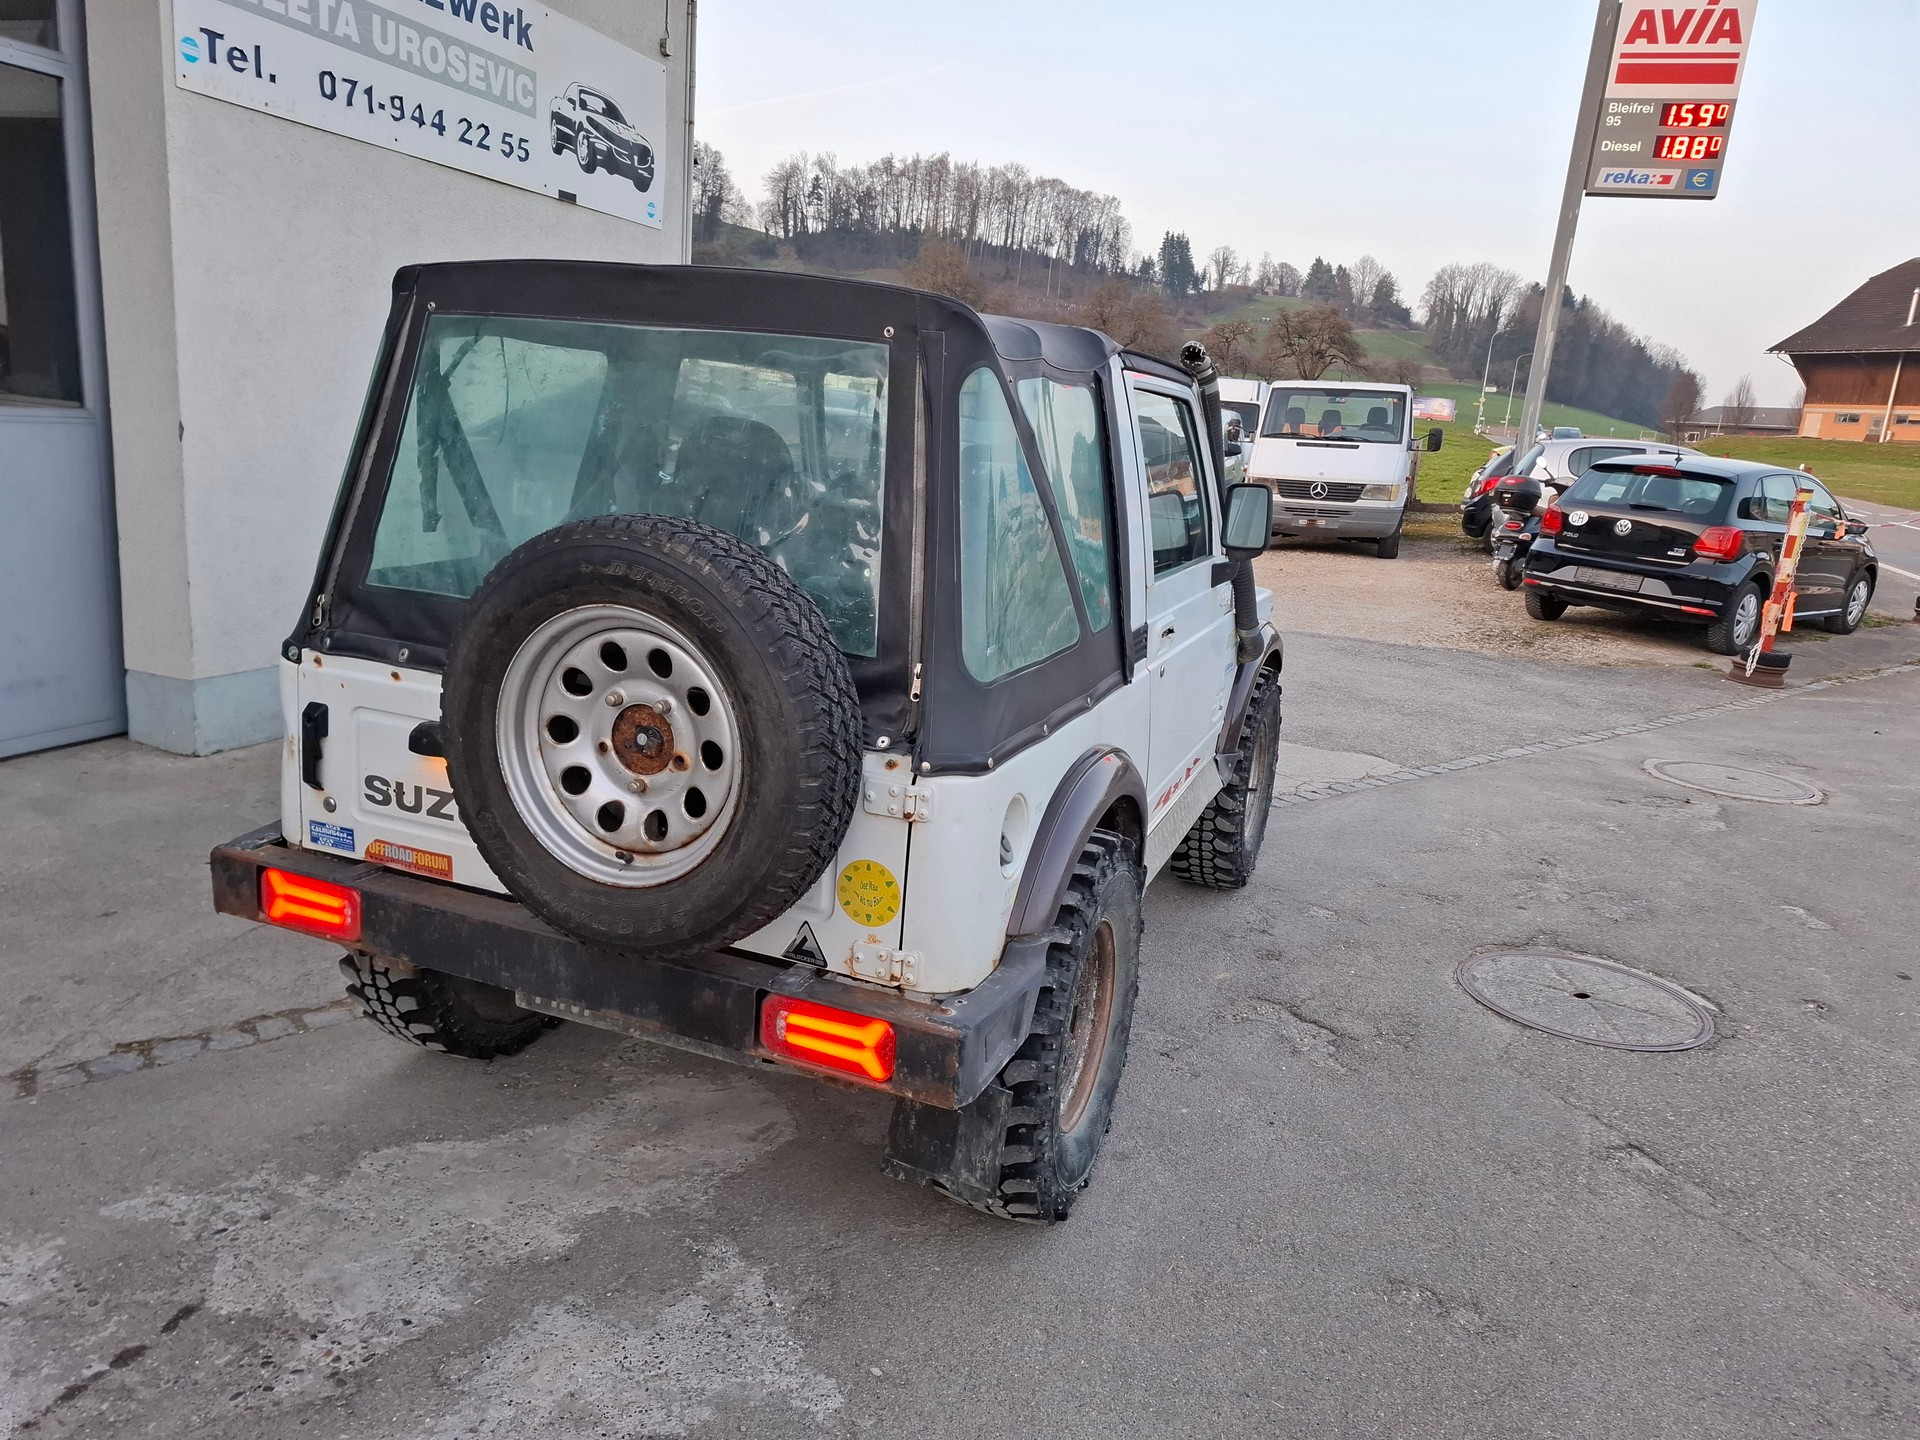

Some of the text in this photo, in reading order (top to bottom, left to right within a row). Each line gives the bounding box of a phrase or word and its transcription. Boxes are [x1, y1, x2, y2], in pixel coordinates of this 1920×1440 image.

[372, 13, 534, 109] UROSEVIC
[199, 27, 277, 84] Tel.
[318, 70, 446, 136] 071-944
[457, 117, 491, 151] 22
[500, 132, 530, 162] 55
[1608, 102, 1654, 114] Bleifrei
[1606, 116, 1622, 126] 95
[1601, 141, 1641, 152] Diesel
[1571, 512, 1585, 523] CH
[604, 560, 726, 633] DUNLOP
